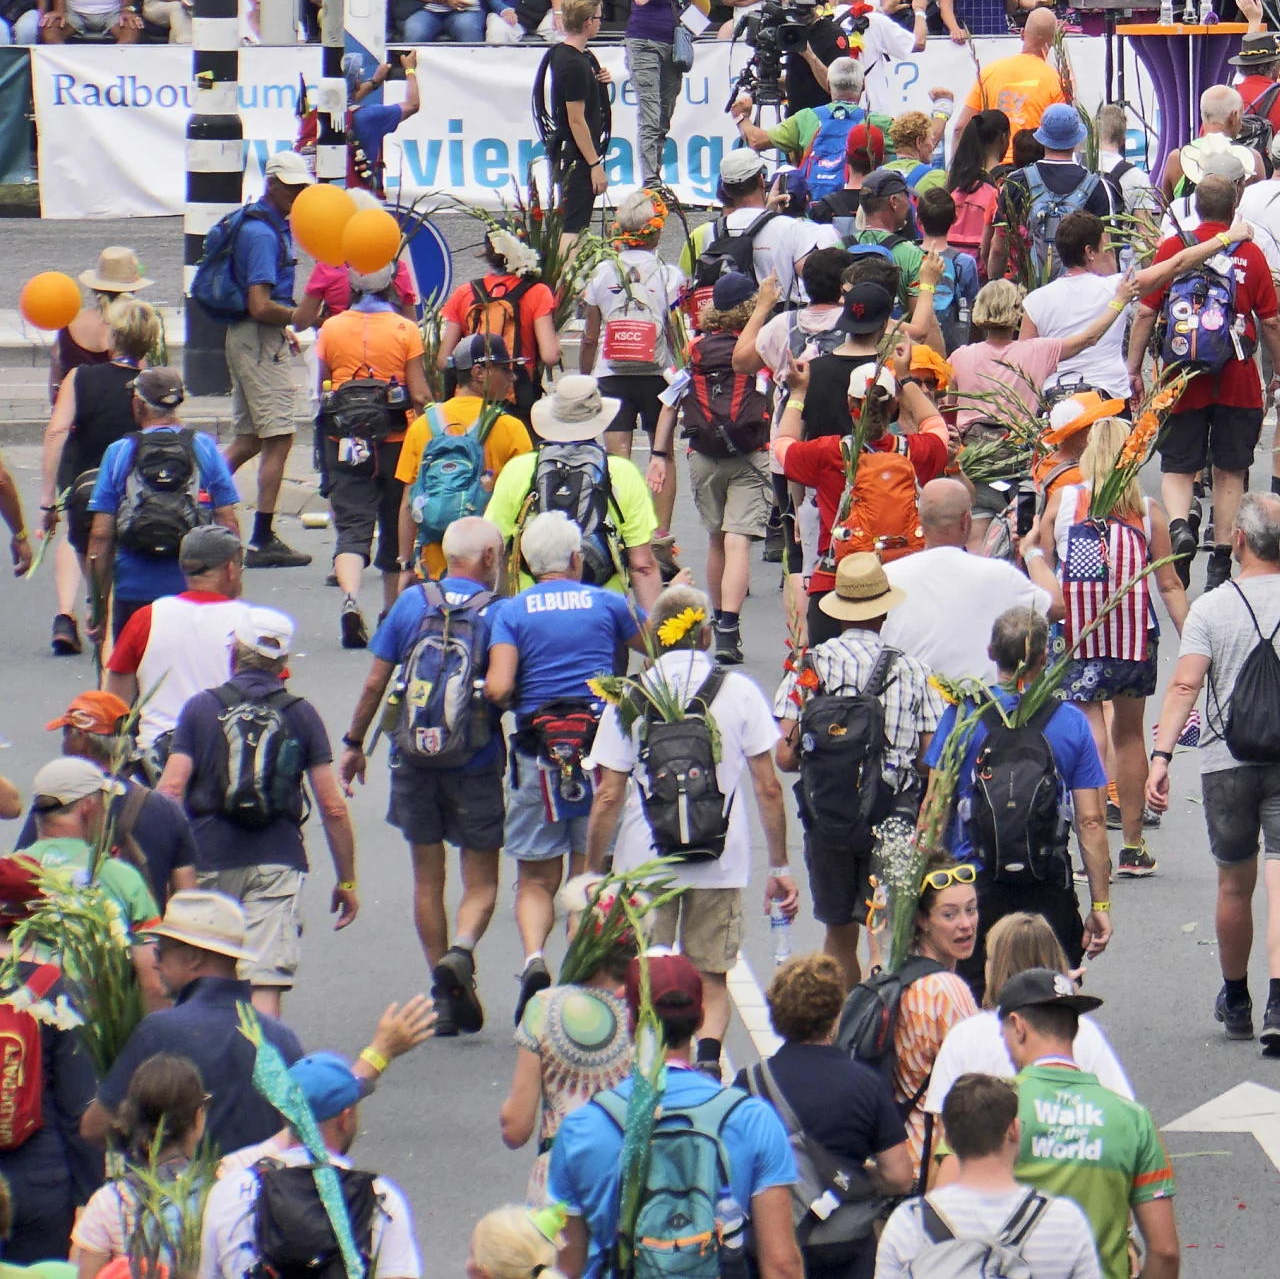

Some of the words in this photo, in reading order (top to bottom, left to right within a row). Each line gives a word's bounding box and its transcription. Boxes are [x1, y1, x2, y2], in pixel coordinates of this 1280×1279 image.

[614, 330, 642, 342] KSCC
[526, 589, 593, 614] ELBURG
[1056, 1090, 1081, 1106] The
[1033, 1099, 1104, 1127] Walk
[1065, 1125, 1089, 1140] the
[1031, 1136, 1104, 1161] World
